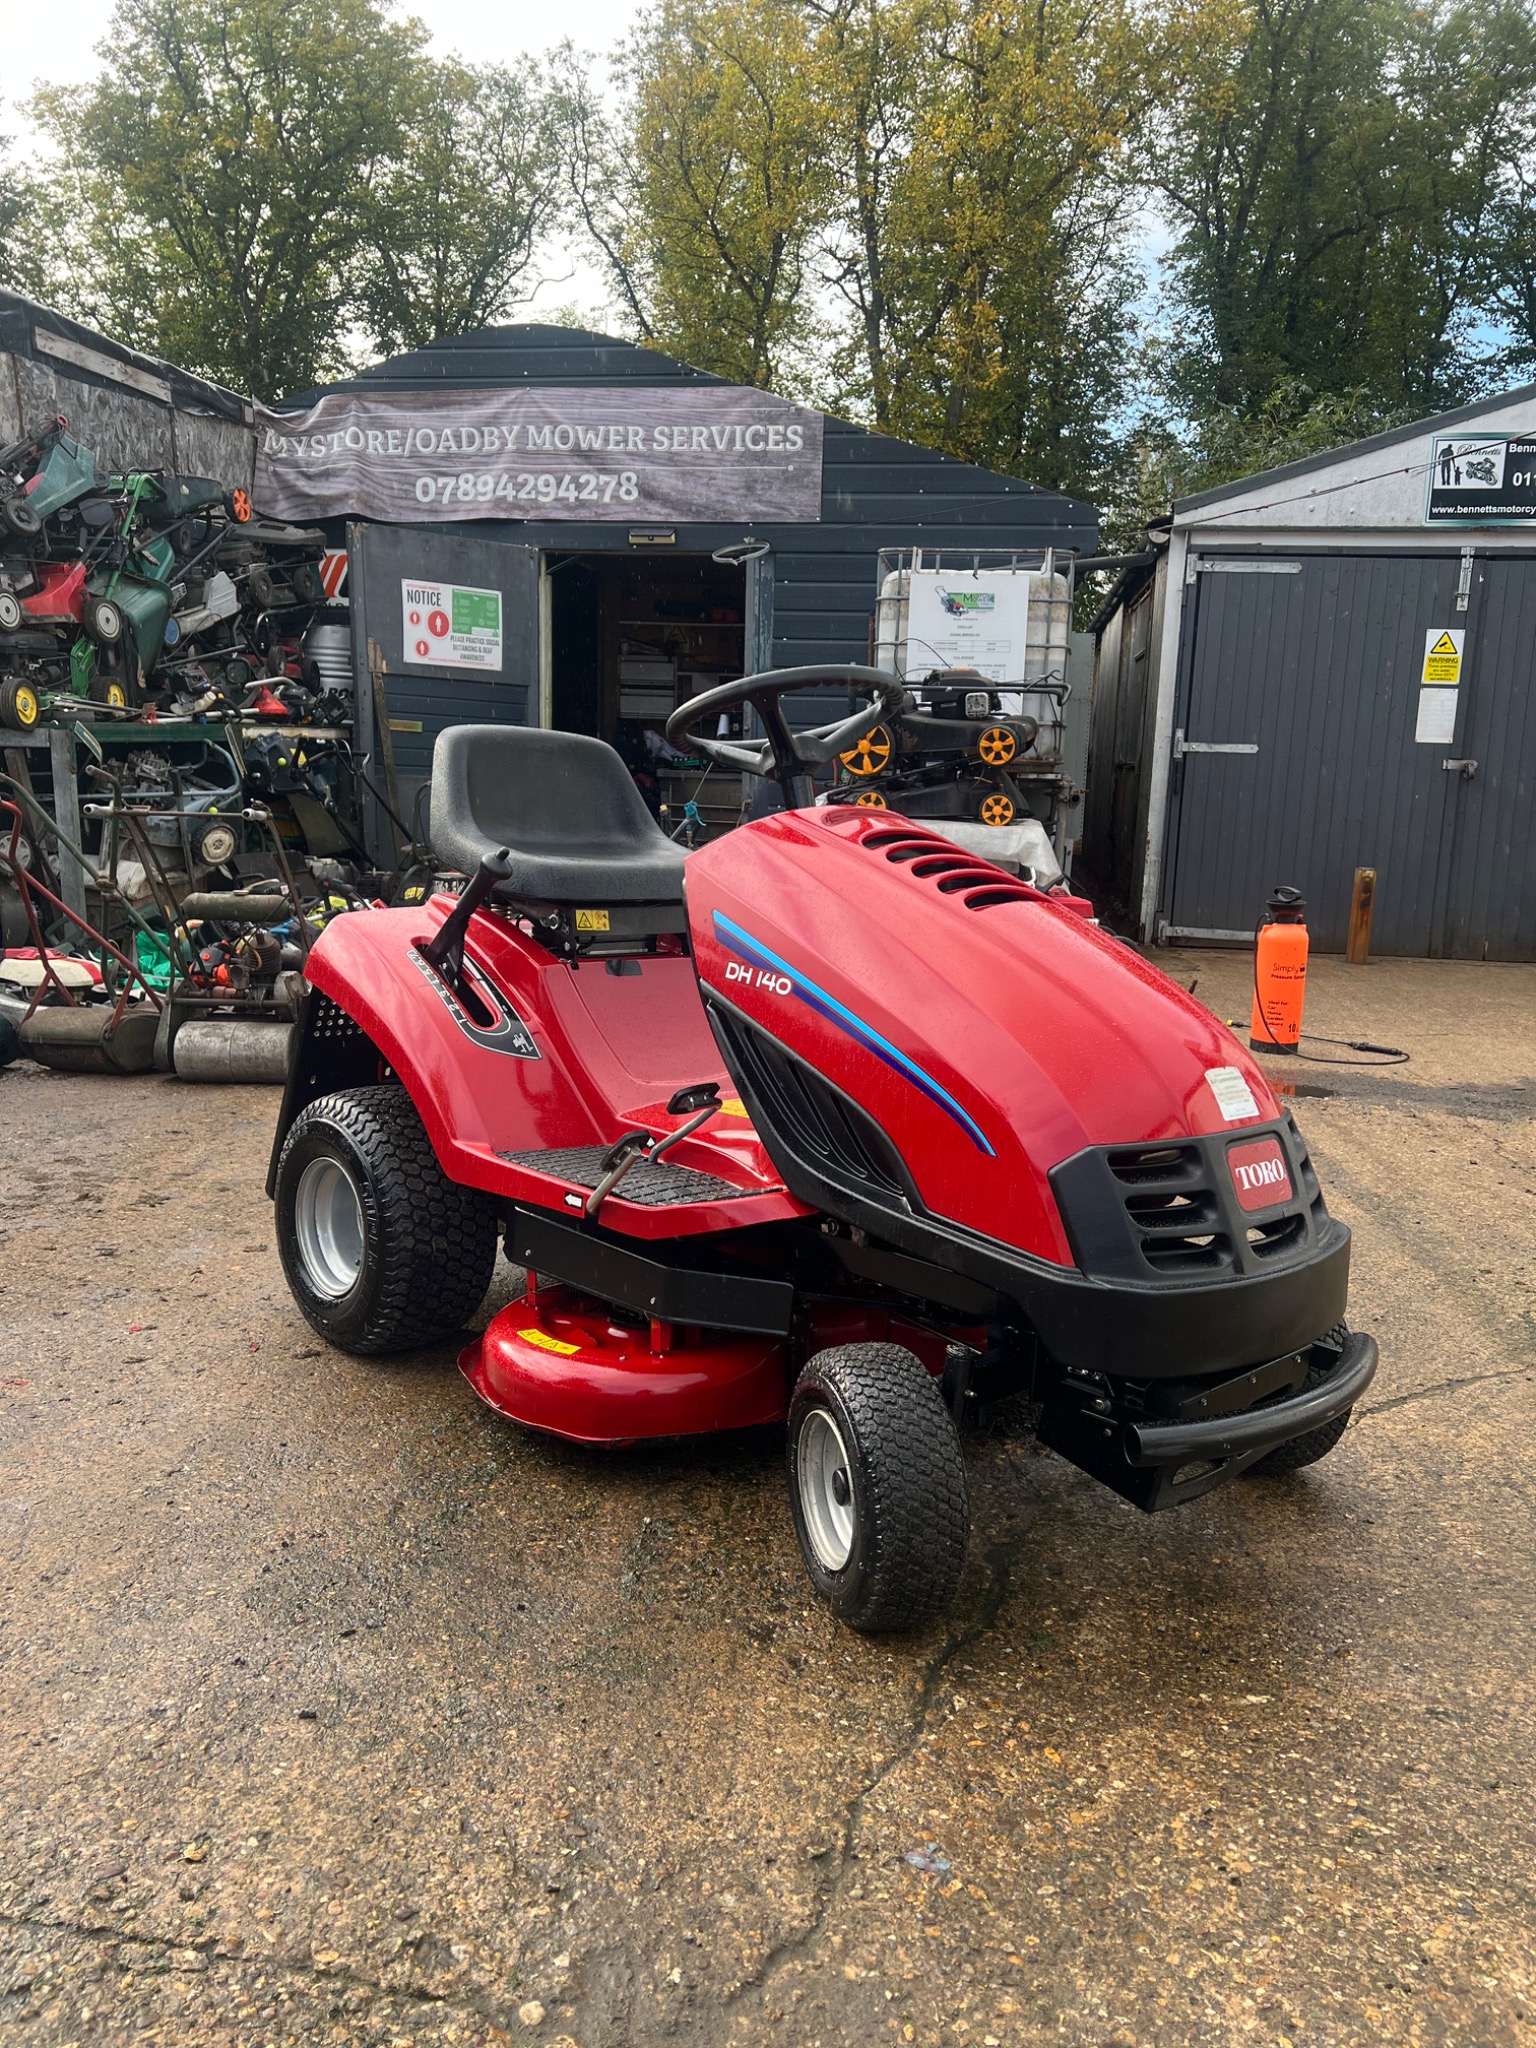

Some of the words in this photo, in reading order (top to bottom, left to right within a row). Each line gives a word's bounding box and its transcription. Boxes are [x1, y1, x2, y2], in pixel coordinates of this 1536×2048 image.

[263, 425, 520, 458] MYSTORE/OADBY
[526, 424, 647, 451] MOWER
[652, 424, 803, 451] SERVICES
[415, 471, 639, 504] 07894294278
[406, 588, 442, 606] NOTICE
[450, 634, 465, 643] PLEASE
[466, 636, 484, 645] PRACTICE
[486, 638, 500, 646] SOCIAL
[452, 644, 477, 654] DISTANCING
[725, 962, 754, 984] DH
[756, 970, 792, 996] 140
[1273, 962, 1299, 974] Simply
[1235, 1158, 1285, 1190] TORO
